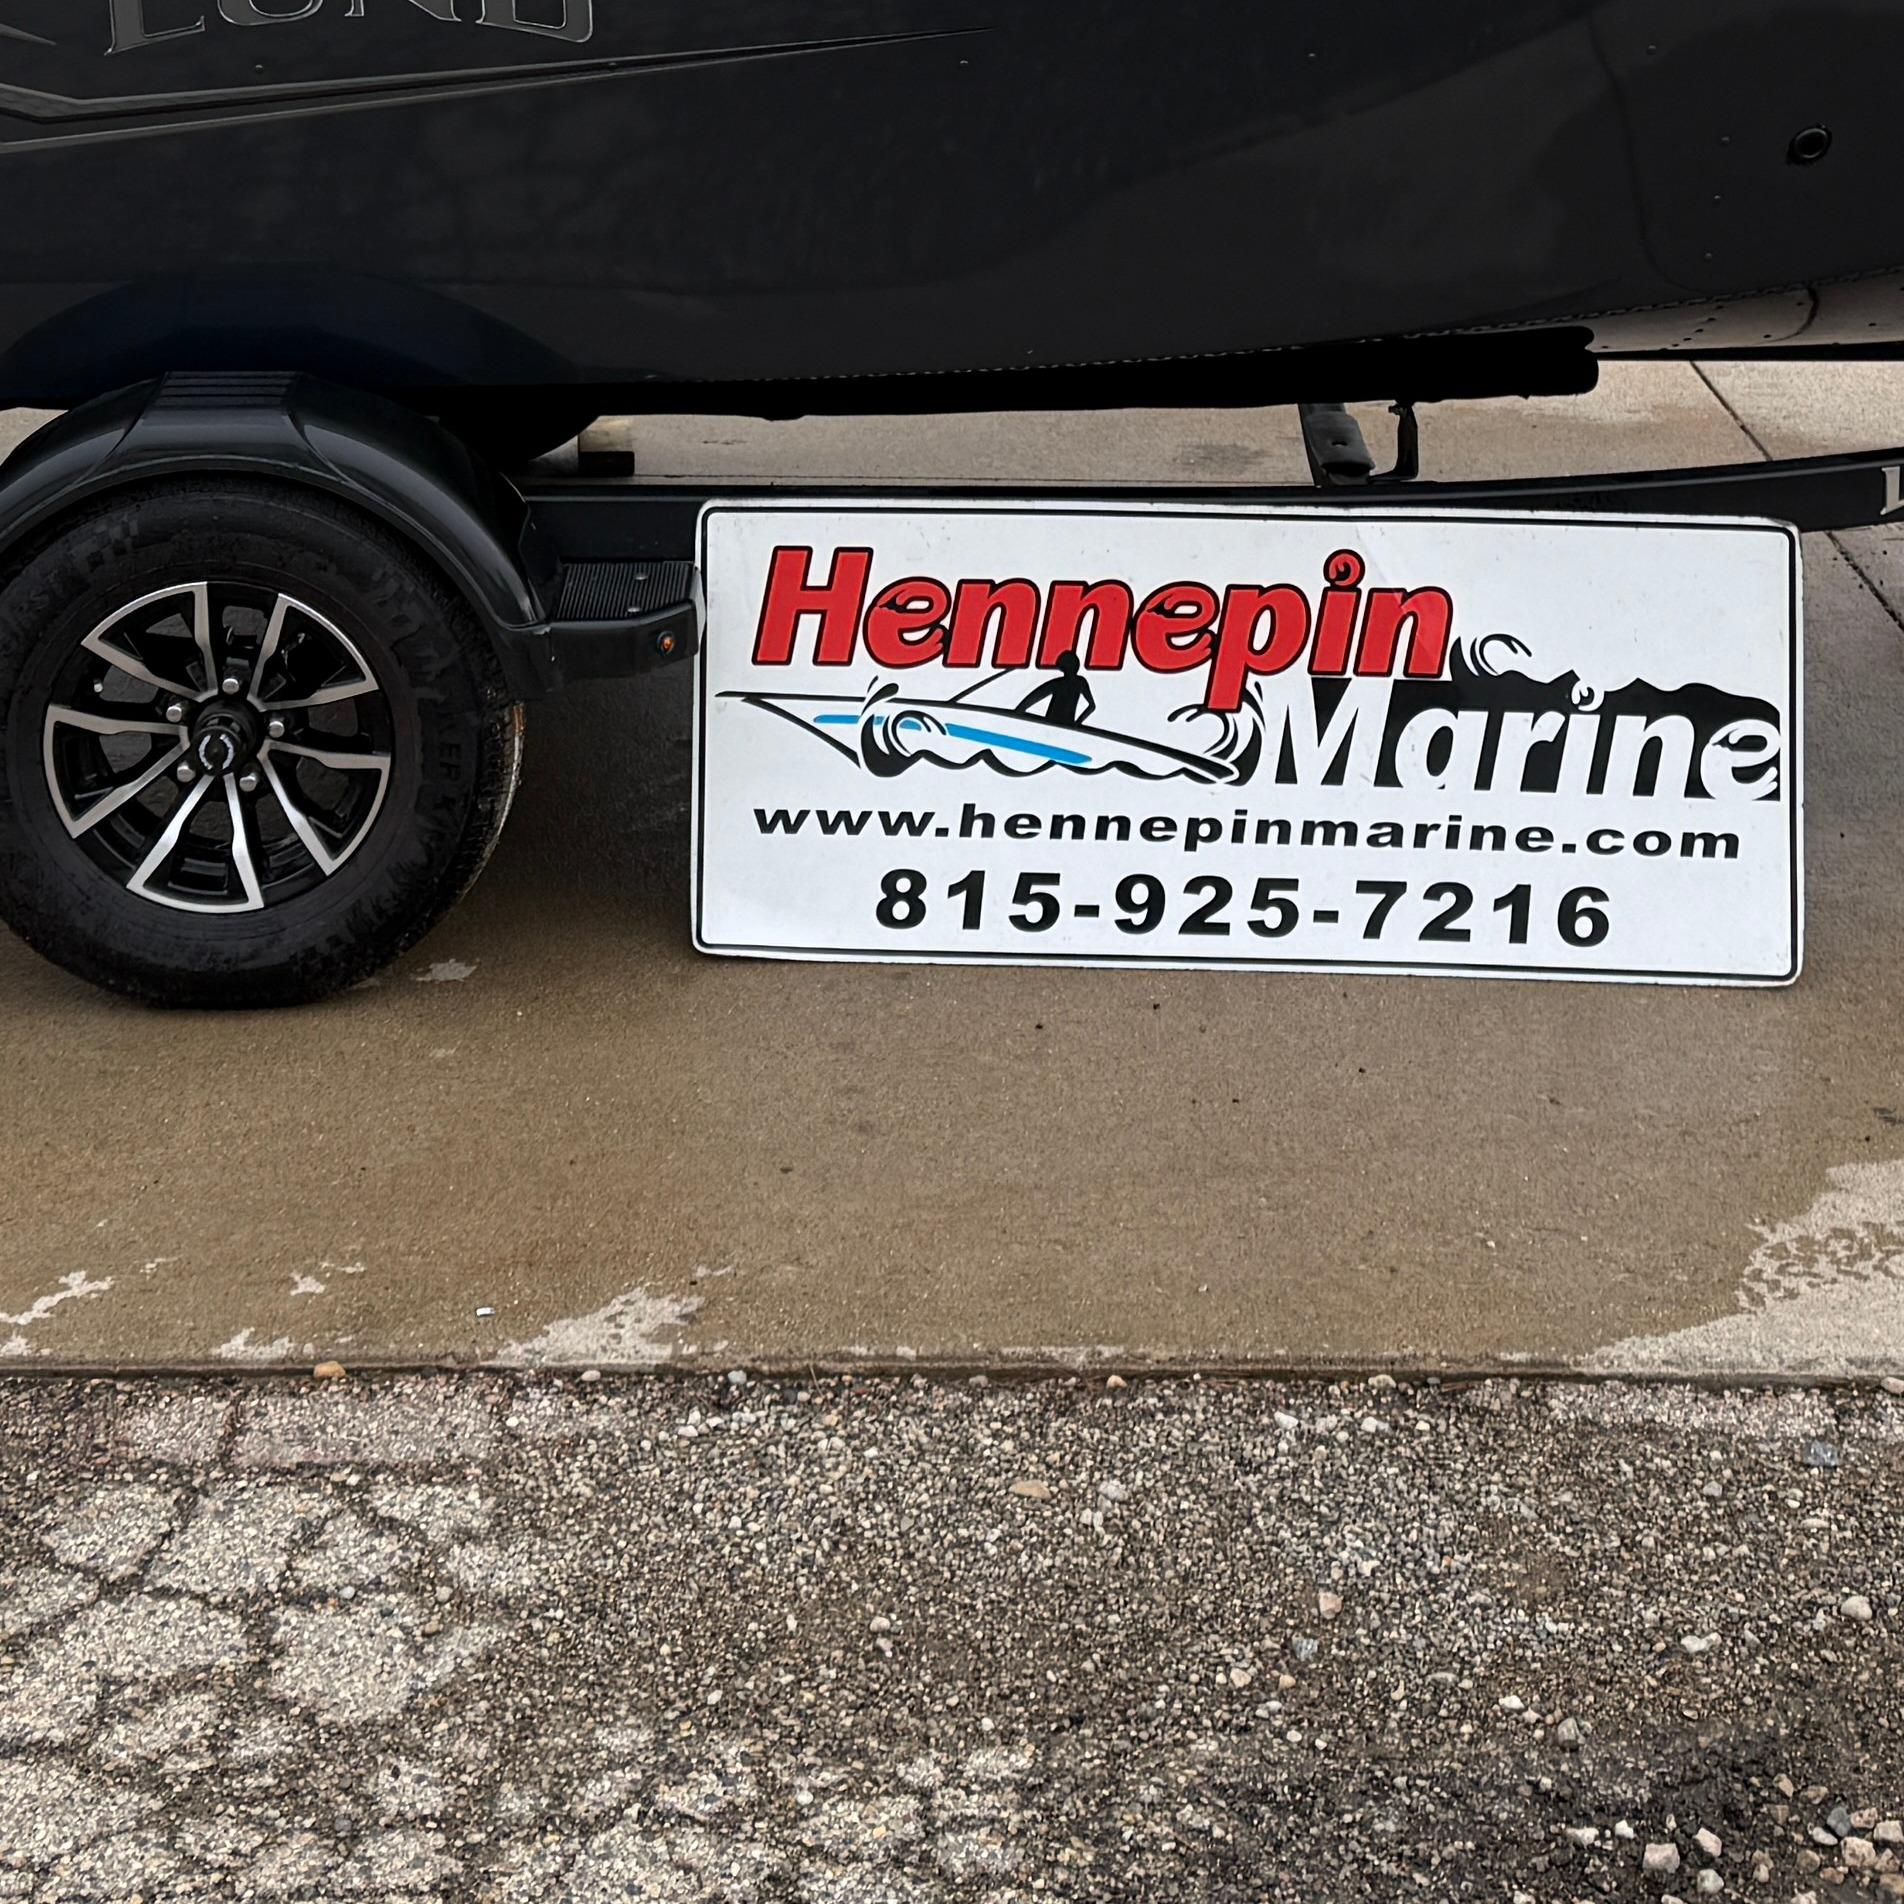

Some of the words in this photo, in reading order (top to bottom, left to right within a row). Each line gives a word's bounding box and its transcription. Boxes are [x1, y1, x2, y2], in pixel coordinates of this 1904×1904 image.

[751, 544, 1454, 713] Hennepin
[1259, 676, 1782, 802] Marine
[752, 802, 1741, 860] www.hennepinmarine.com
[874, 867, 1611, 949] 815-925-7216
